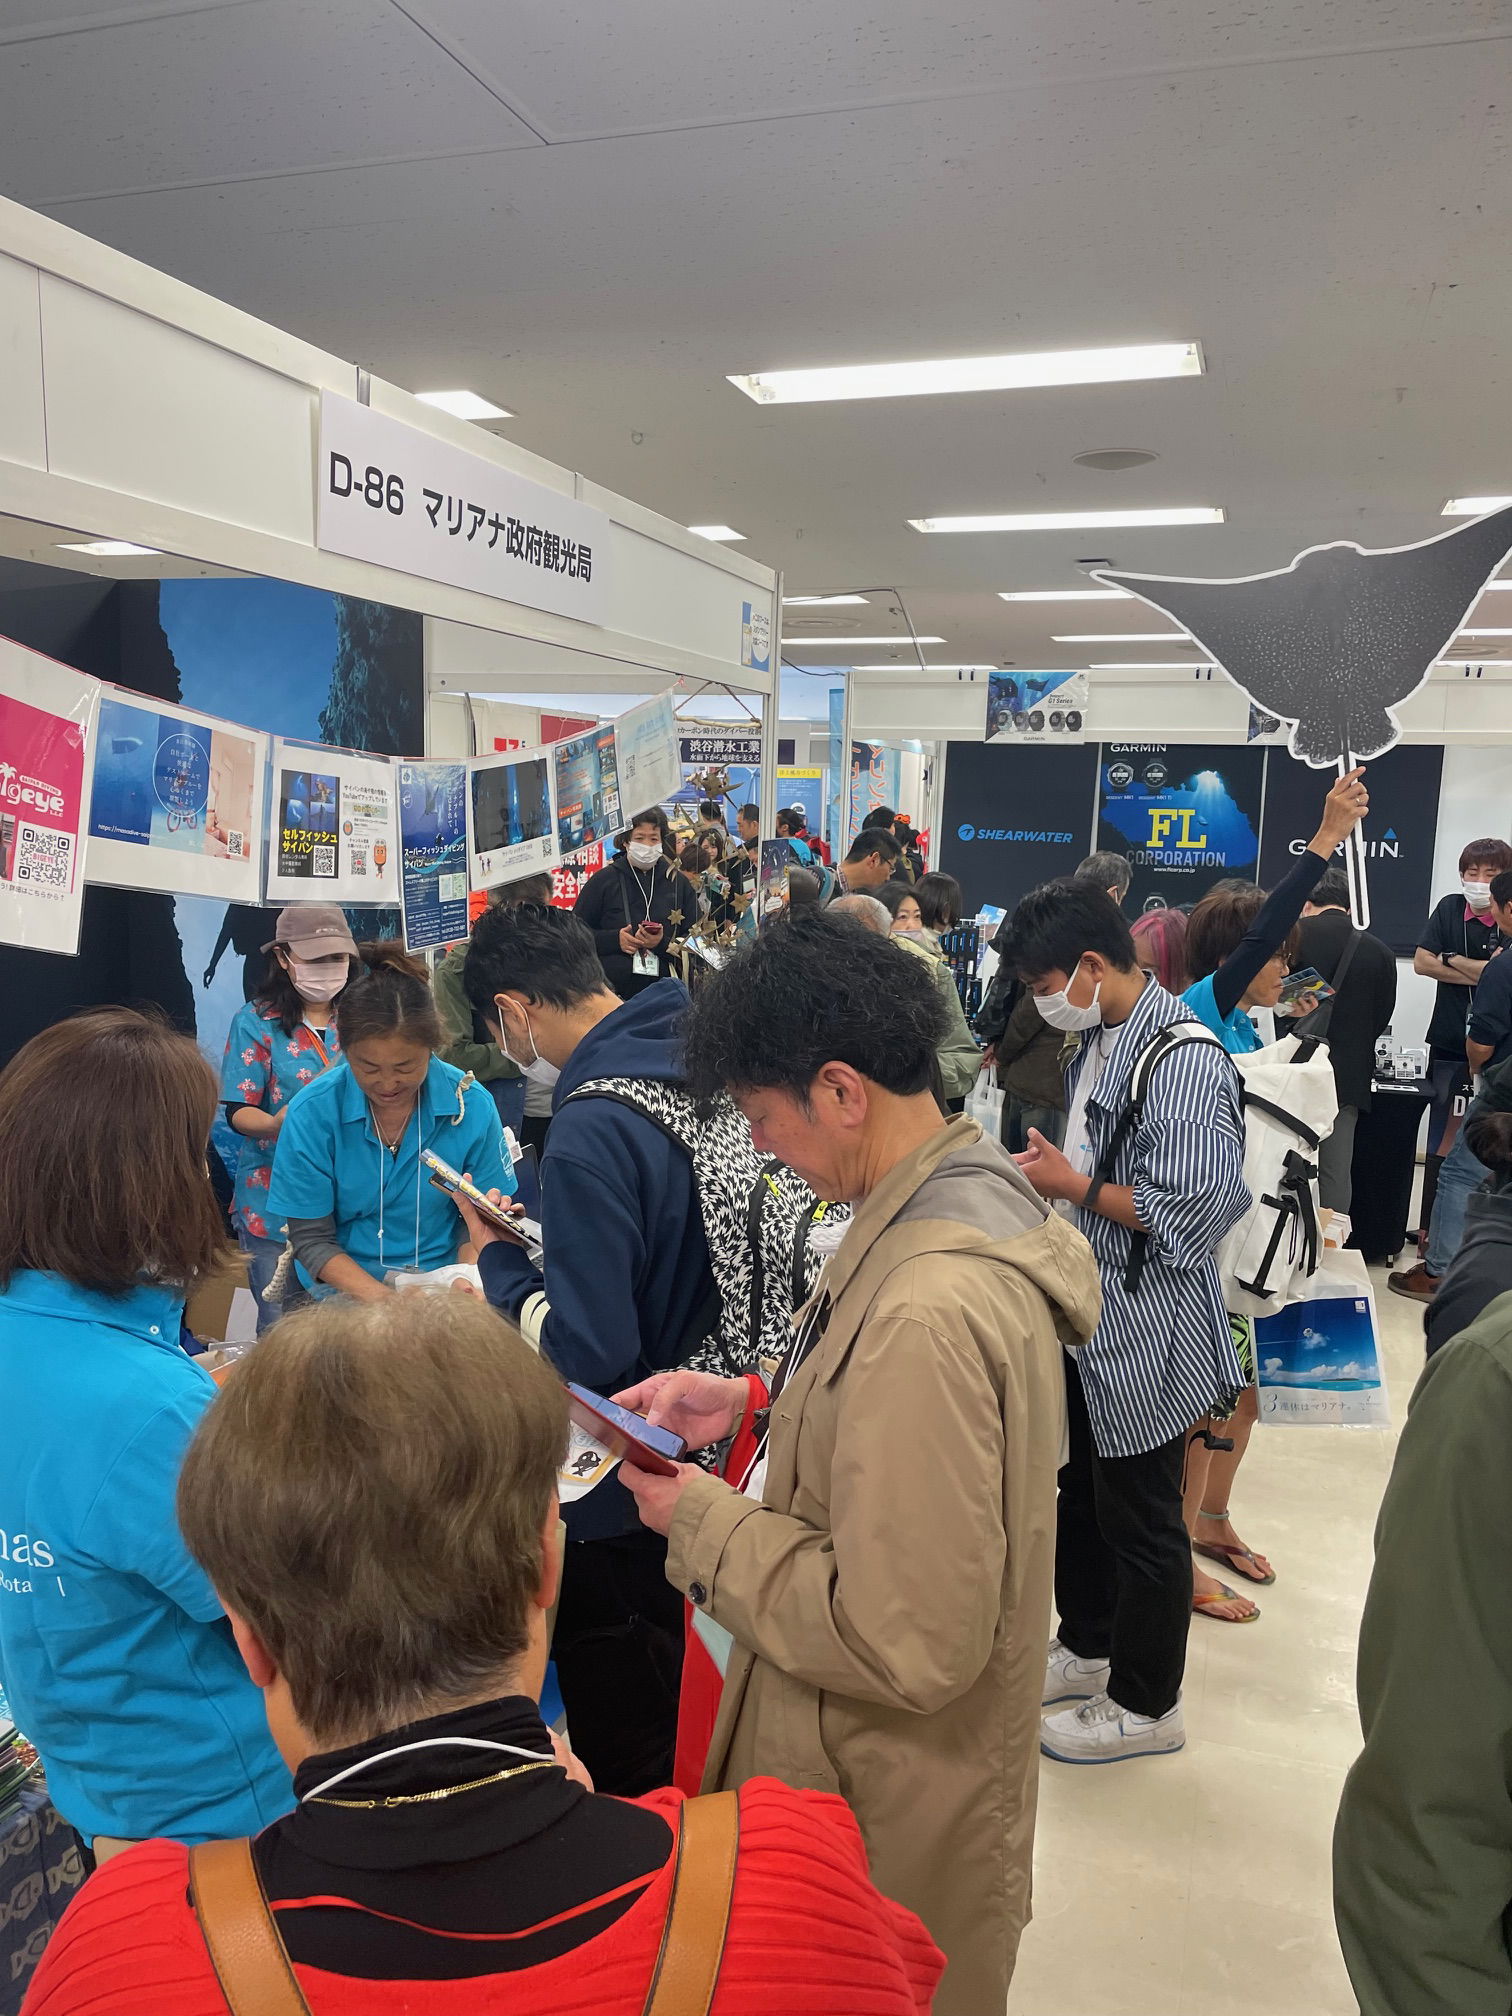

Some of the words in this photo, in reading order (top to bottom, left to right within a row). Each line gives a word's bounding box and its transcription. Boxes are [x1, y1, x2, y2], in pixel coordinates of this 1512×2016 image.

[330, 451, 405, 516] D-86
[422, 487, 593, 583] マリアナ政府観光局
[689, 739, 760, 753] 渋谷潜水工業
[1110, 743, 1167, 753] GARMIN
[282, 828, 338, 843] セルフィッシュ
[977, 829, 1073, 843] SHEARWATER
[1146, 808, 1207, 849] FL
[282, 840, 314, 854] サイパン
[1288, 839, 1399, 858] GRIN
[1126, 849, 1226, 868] CORPORATION
